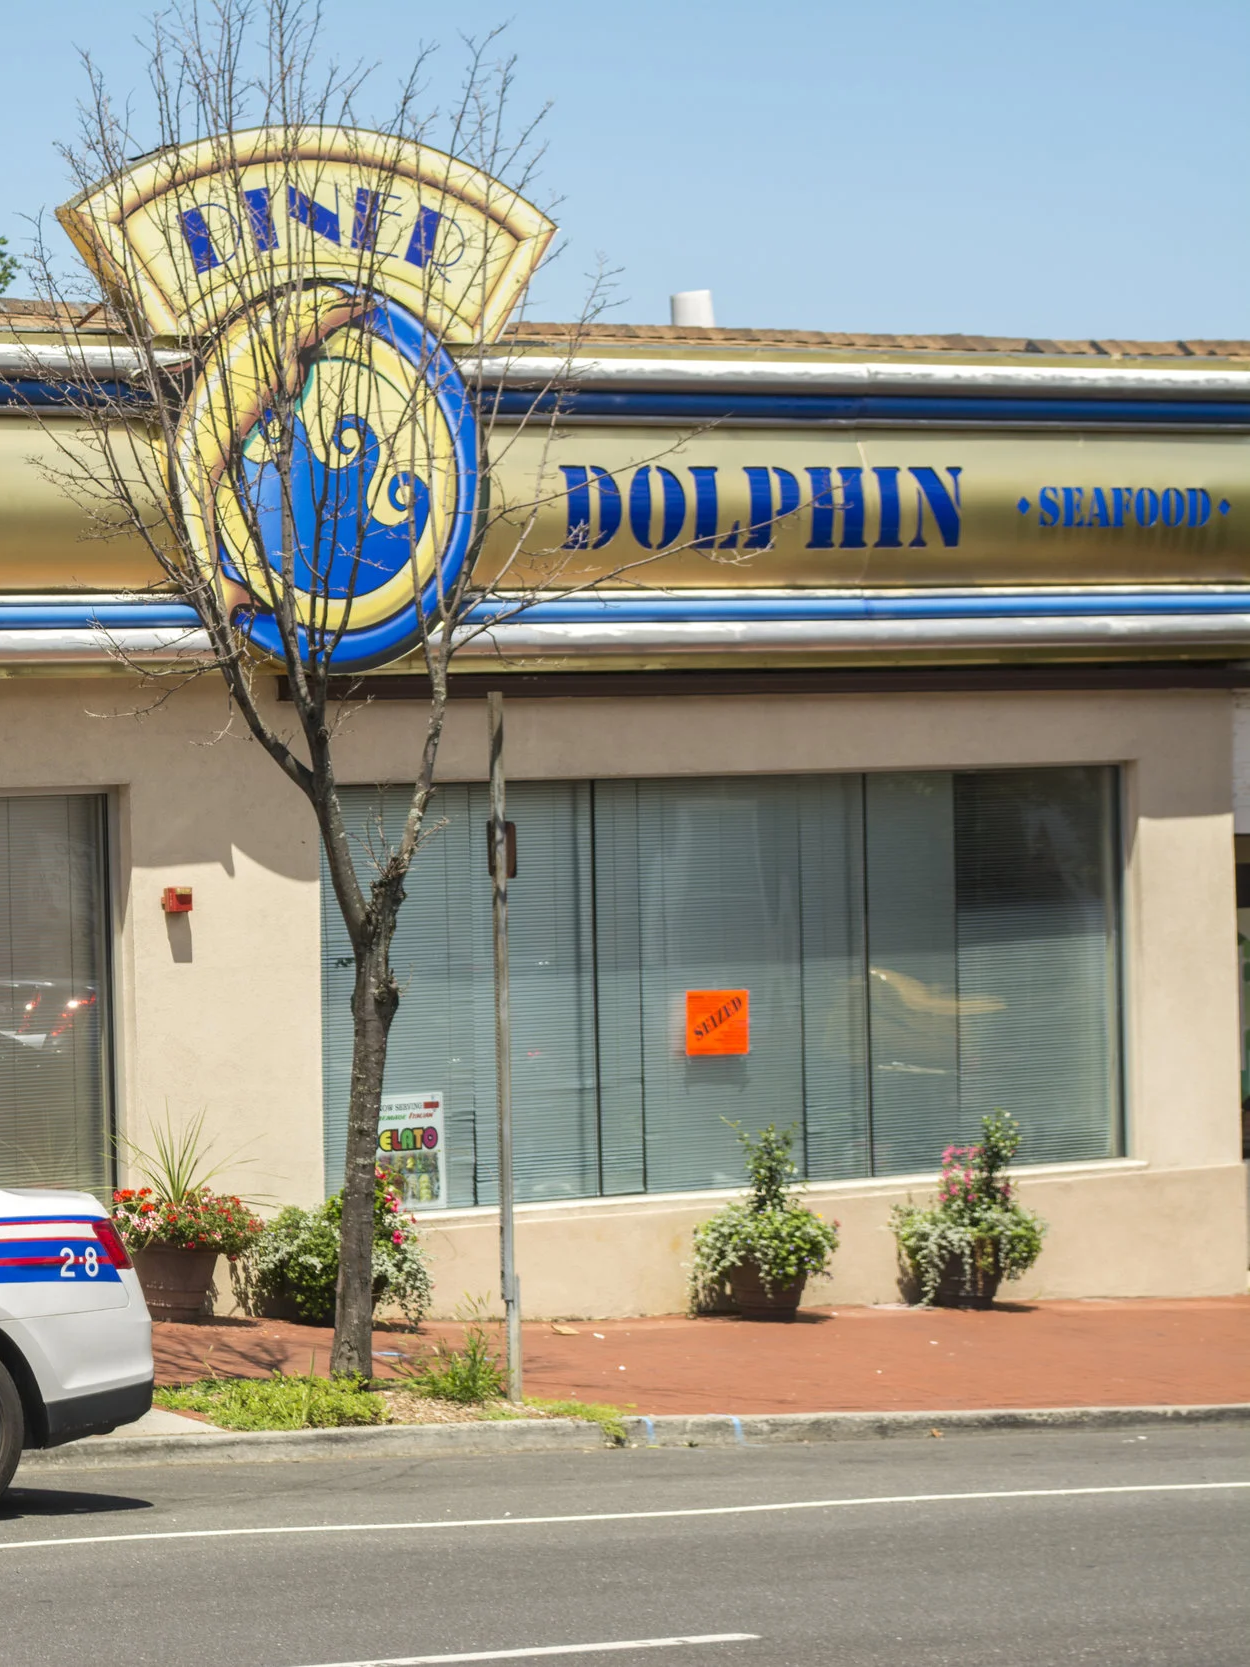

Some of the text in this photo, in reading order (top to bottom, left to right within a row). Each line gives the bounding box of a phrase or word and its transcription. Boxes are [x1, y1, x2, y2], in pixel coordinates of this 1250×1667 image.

[177, 182, 468, 283] DINER
[558, 464, 964, 550] DOLPHIN
[1037, 485, 1212, 529] SEAFOOD
[694, 996, 742, 1041] SEIZED
[395, 1102, 422, 1111] SERVING
[377, 1126, 438, 1152] ELATO
